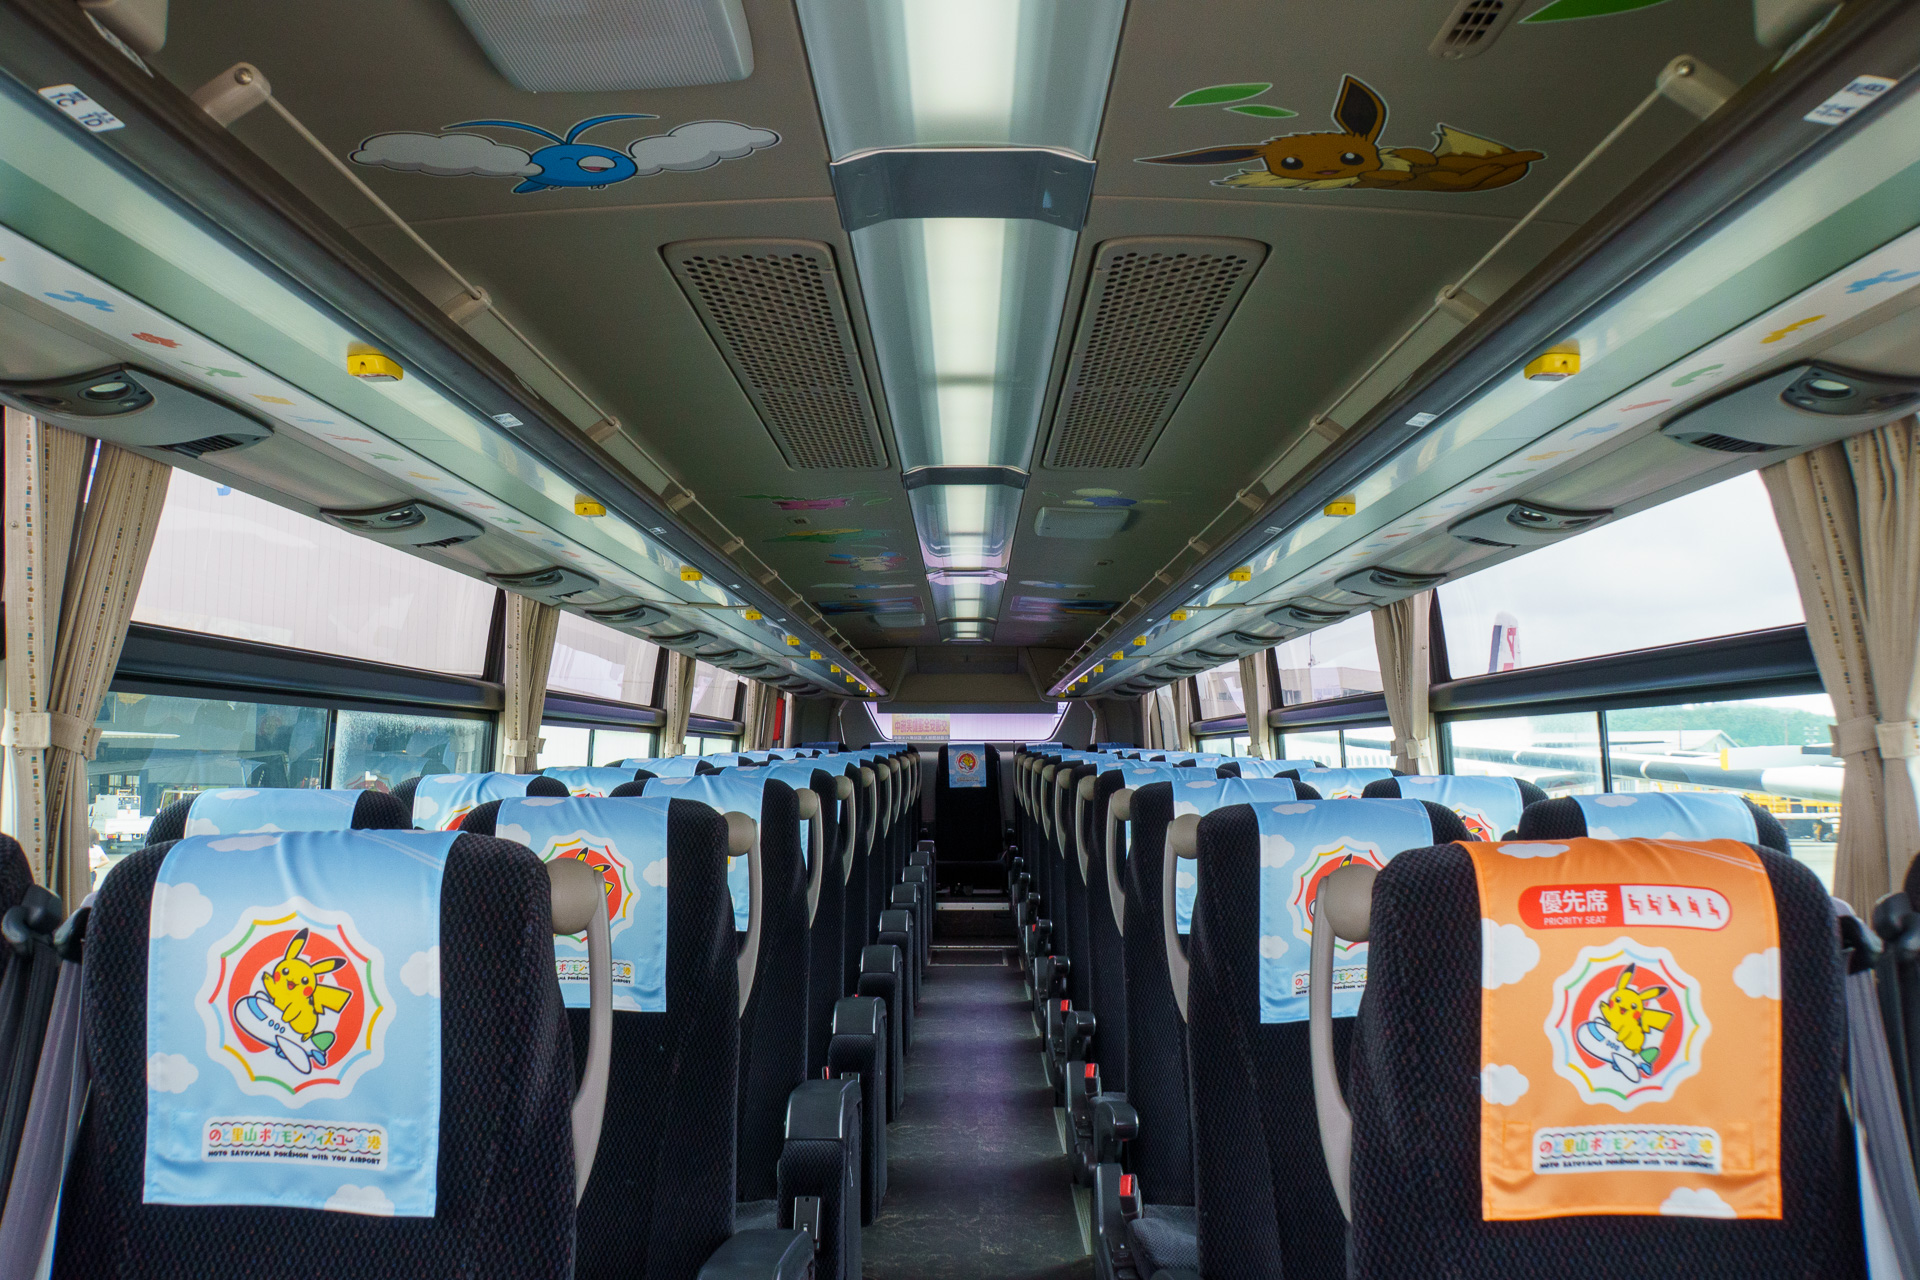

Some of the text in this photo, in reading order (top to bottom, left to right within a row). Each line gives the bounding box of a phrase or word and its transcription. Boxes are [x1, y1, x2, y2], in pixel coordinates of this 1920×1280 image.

[1539, 889, 1609, 914] 優先席
[1543, 915, 1607, 926] PRIORITY SEAT
[230, 1149, 271, 1157] SATOYAMA
[273, 1149, 309, 1158] POKÉMON
[331, 1154, 347, 1162] YOU
[349, 1156, 381, 1165] AIRPORT
